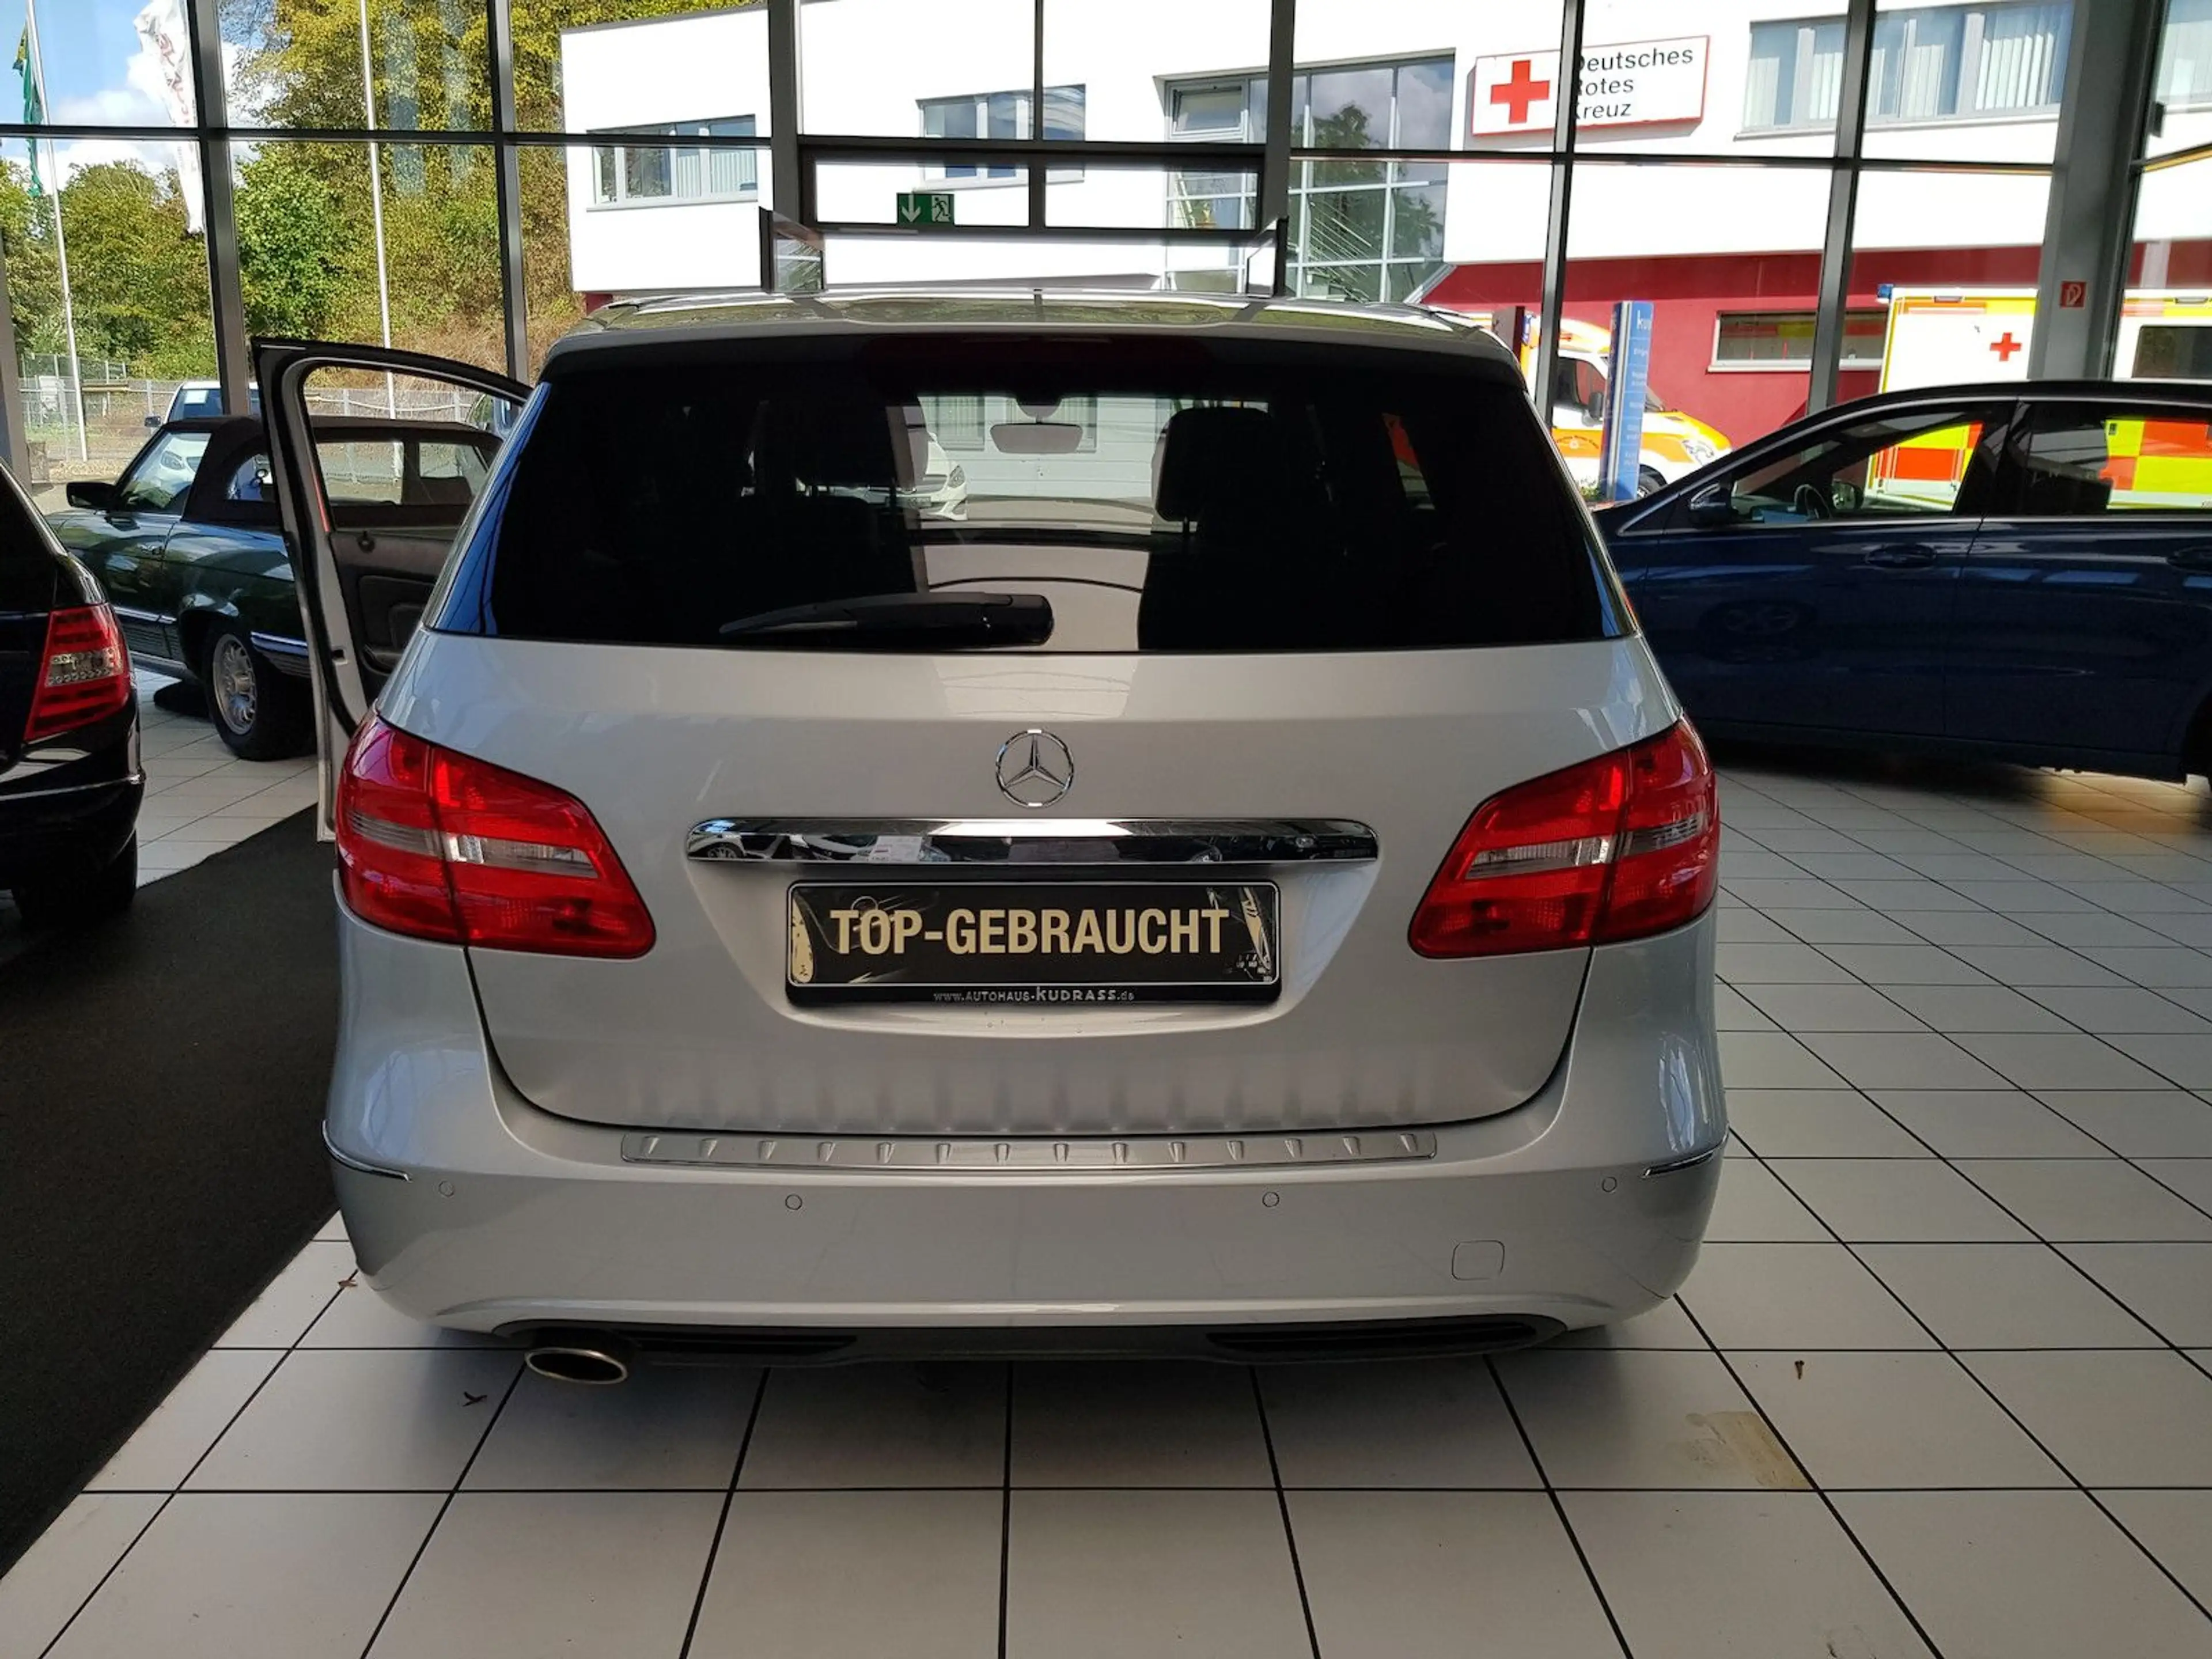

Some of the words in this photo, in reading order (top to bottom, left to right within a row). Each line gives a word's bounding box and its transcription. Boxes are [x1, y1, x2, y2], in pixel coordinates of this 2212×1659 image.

[1578, 77, 1634, 96] otes
[1576, 102, 1632, 119] reuz
[830, 908, 1229, 955] TOP-GEBRAUCHT
